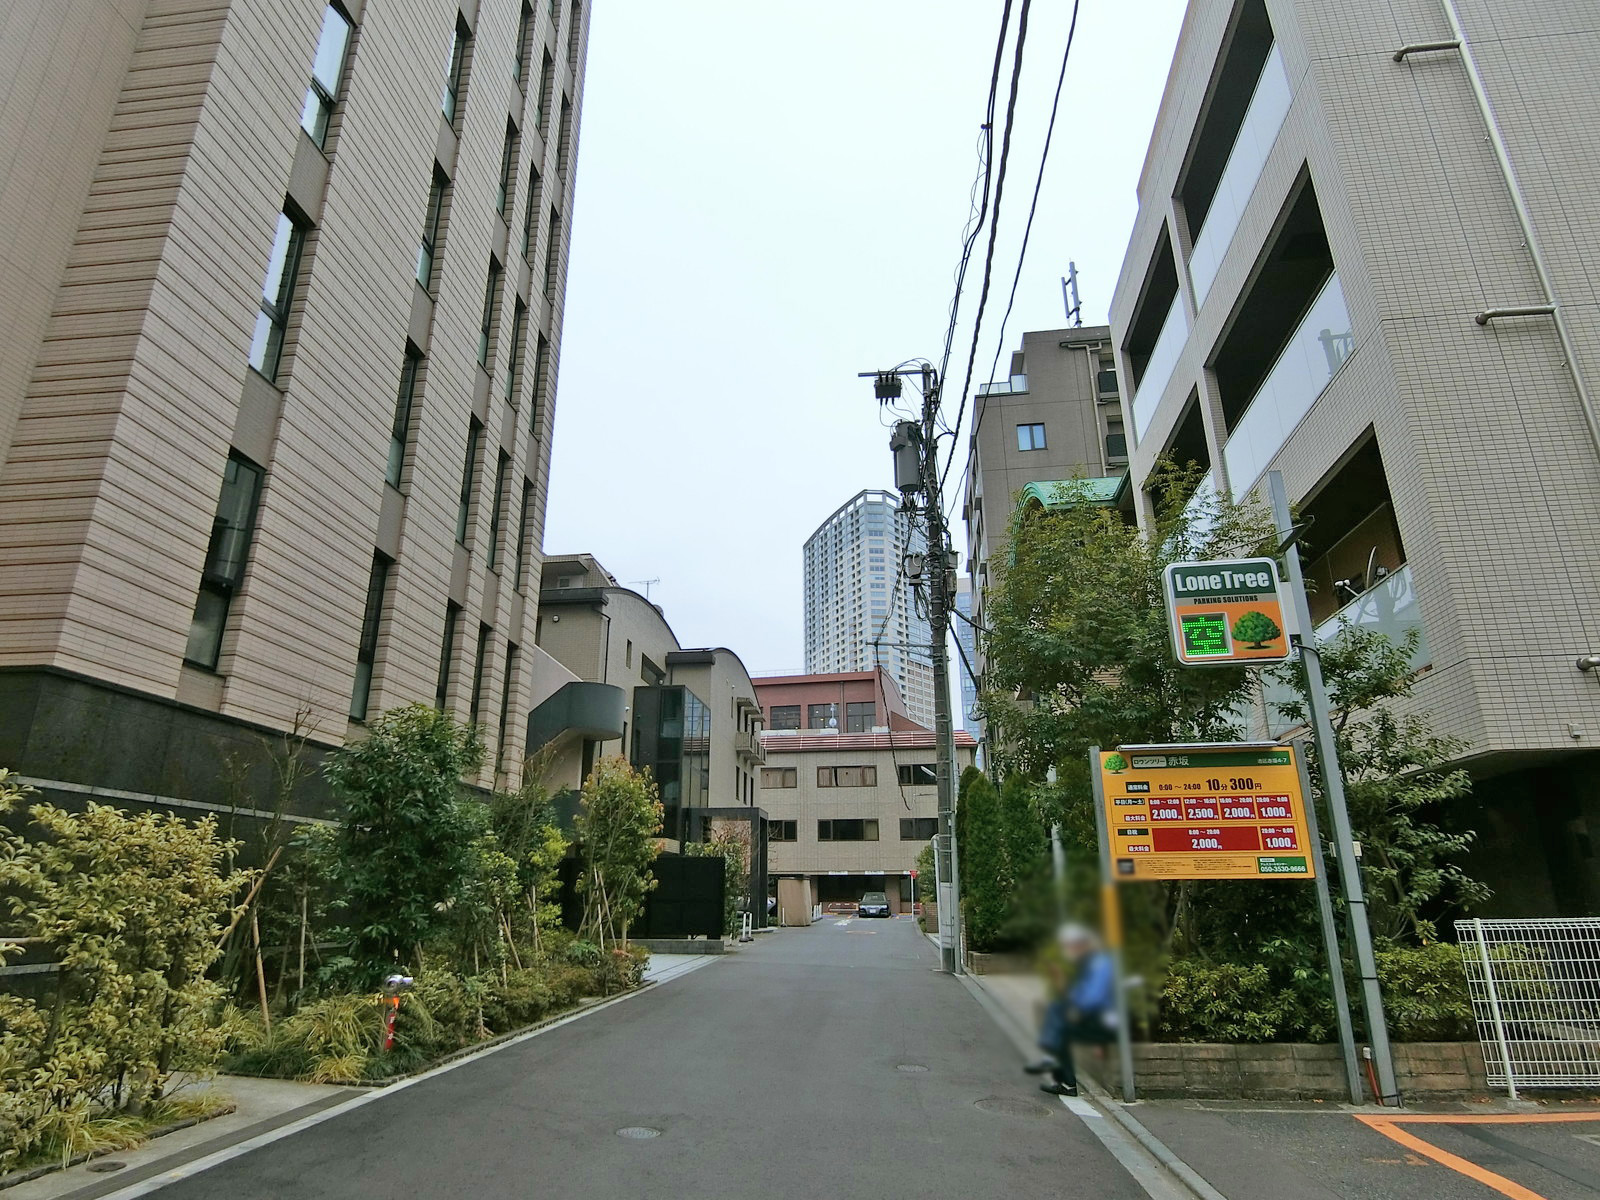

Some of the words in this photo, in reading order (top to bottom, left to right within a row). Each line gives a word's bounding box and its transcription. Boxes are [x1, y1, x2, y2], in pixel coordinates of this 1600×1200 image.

[1174, 570, 1270, 592] LoneTree
[1193, 597, 1222, 605] PARKING
[1222, 595, 1258, 604] SOLUTIONS
[1182, 616, 1229, 655] 空
[1168, 756, 1189, 766] 赤坂
